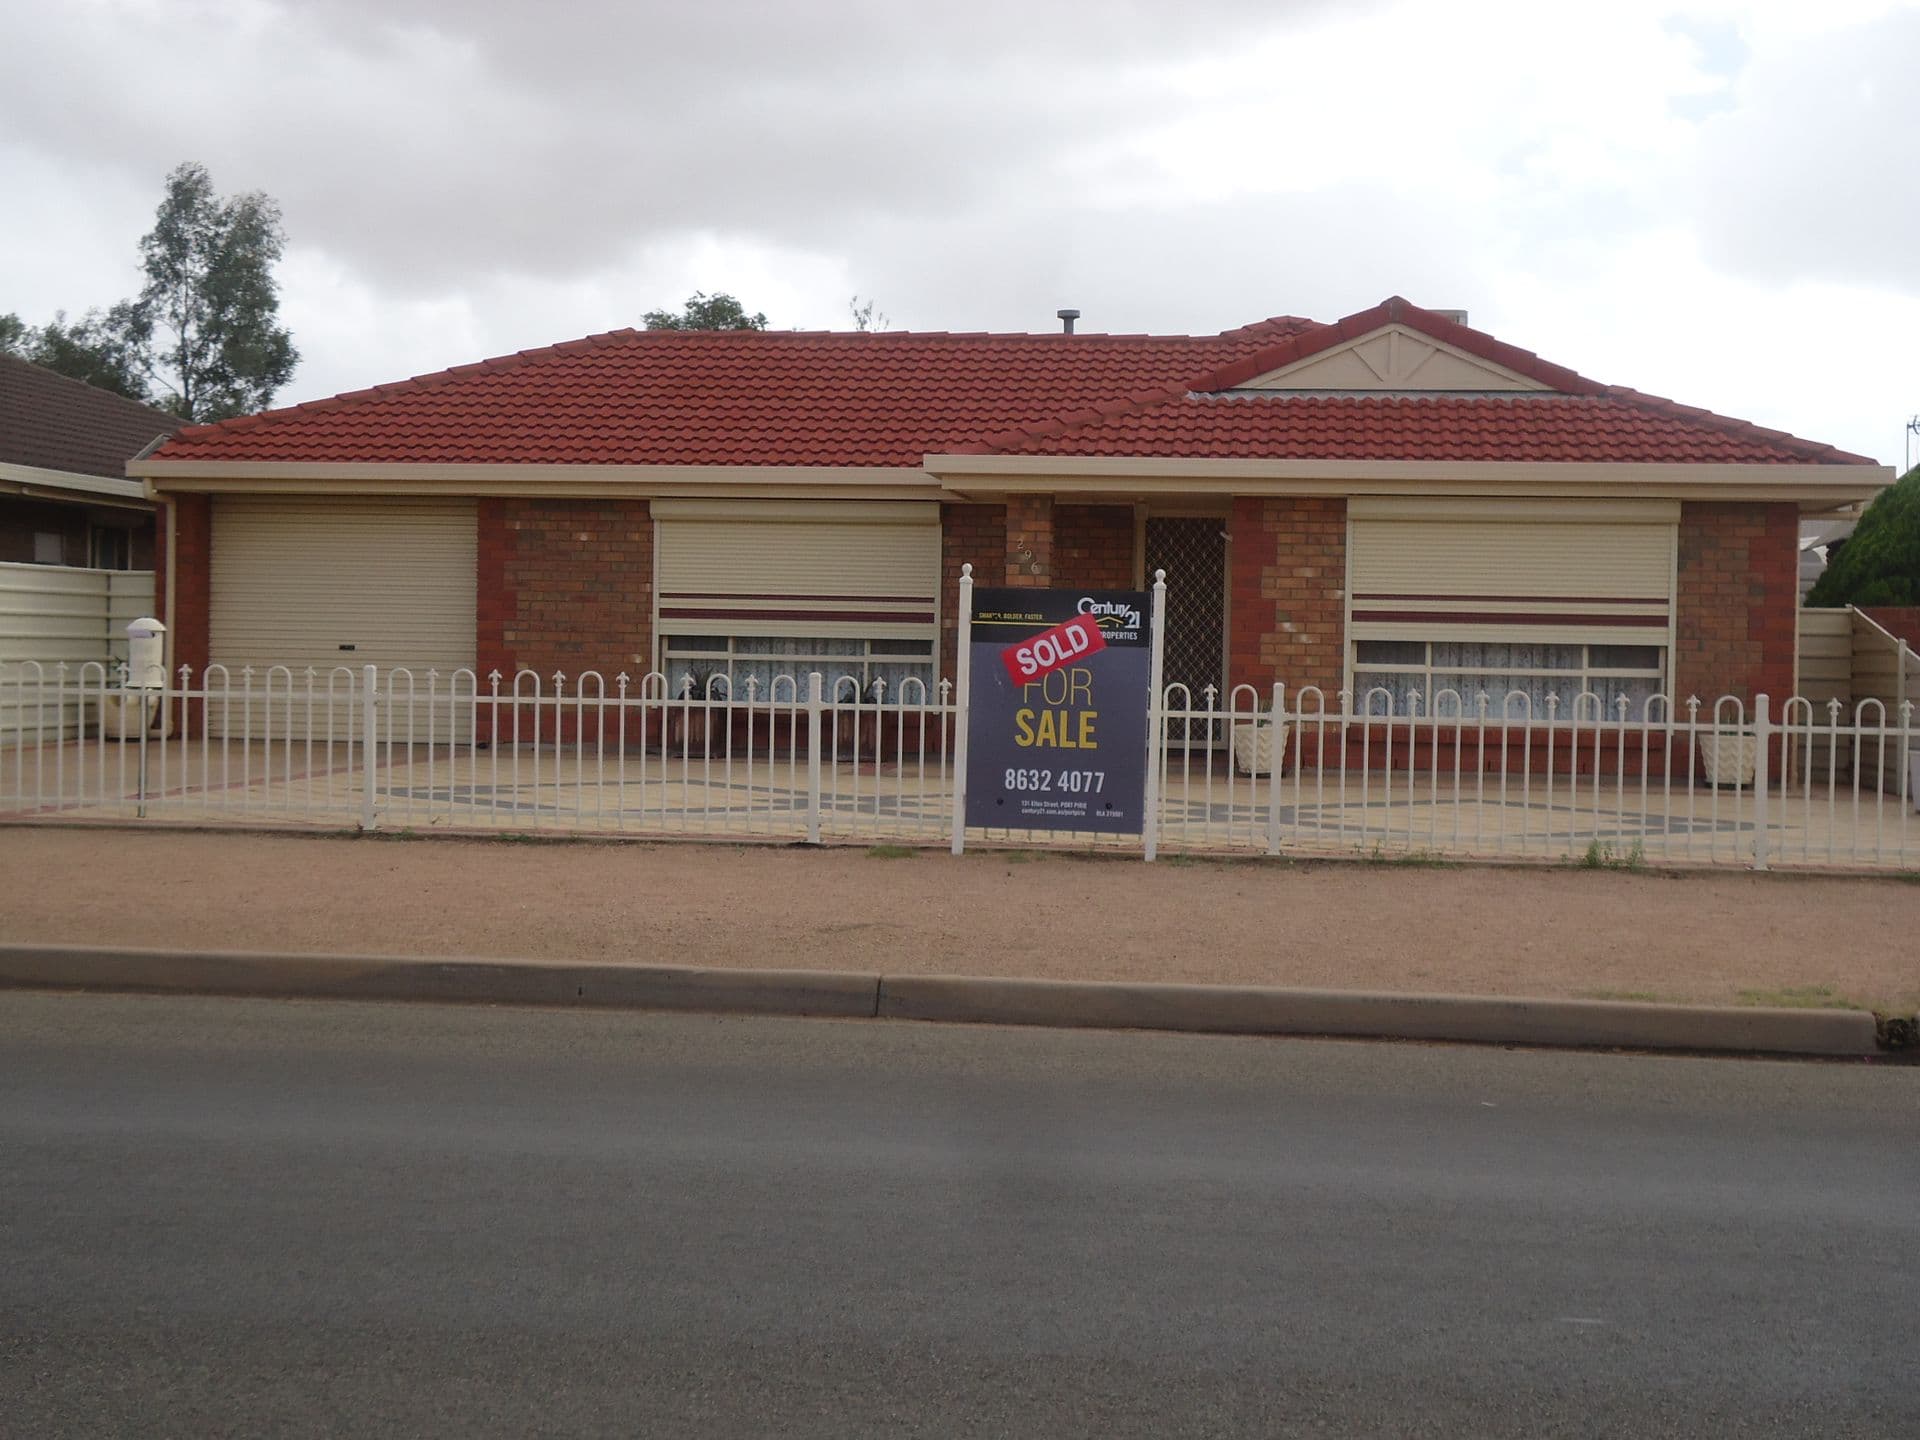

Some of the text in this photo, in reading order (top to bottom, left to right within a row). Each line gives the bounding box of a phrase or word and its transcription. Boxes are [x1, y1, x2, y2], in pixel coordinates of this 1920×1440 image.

[1077, 597, 1131, 618] Century
[1124, 610, 1141, 629] 21
[1016, 624, 1089, 675] SOLD
[1014, 708, 1098, 749] SALE
[1005, 768, 1105, 793] 8632 4077
